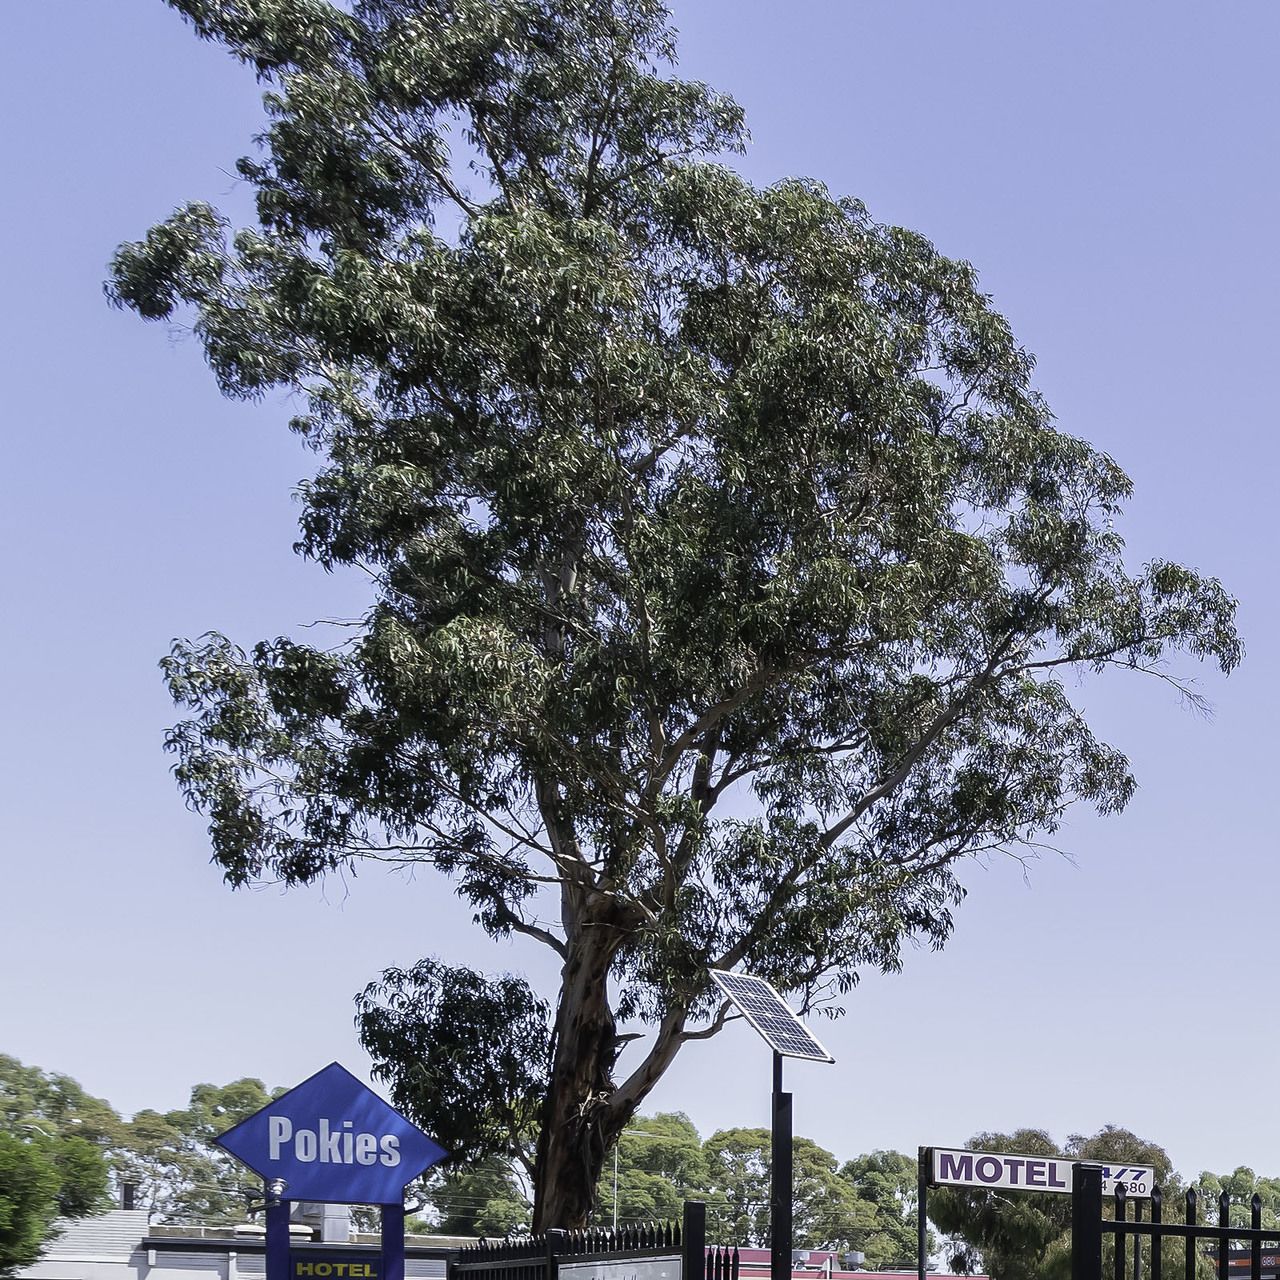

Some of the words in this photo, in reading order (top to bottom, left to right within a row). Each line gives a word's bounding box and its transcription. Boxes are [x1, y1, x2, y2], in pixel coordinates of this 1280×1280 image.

[268, 1116, 401, 1167] Pokies
[939, 1154, 1066, 1188] MOTEL
[296, 1263, 378, 1277] HOTEL
